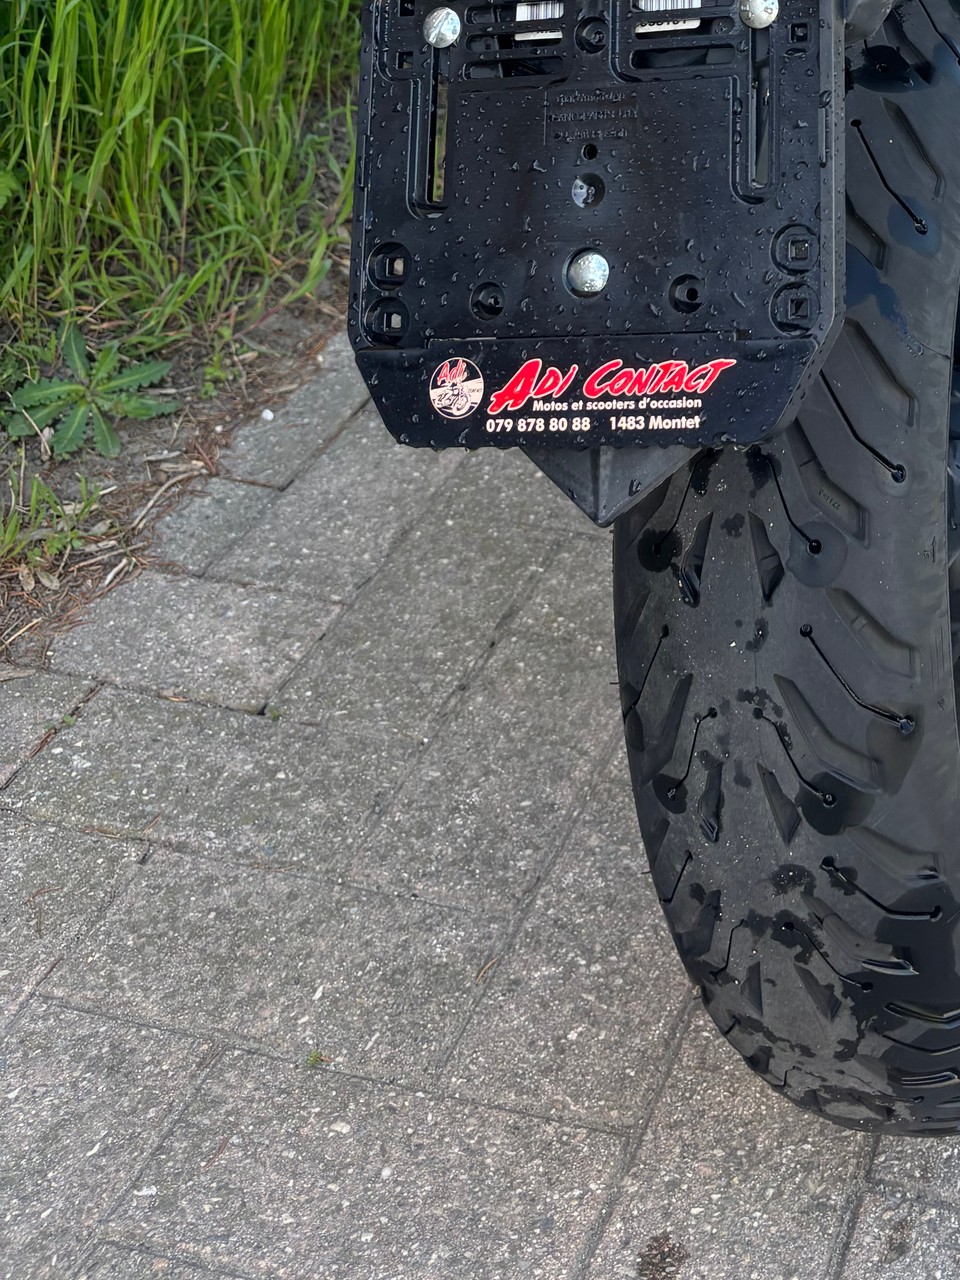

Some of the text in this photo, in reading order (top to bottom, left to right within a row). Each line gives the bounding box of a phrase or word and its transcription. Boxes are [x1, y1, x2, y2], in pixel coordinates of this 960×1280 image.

[437, 359, 468, 386] Adi
[582, 359, 737, 398] CONTACT
[532, 396, 702, 412] Motos et scooters d'occasion
[486, 415, 700, 433] 079 878 80 88 1483 Montet
